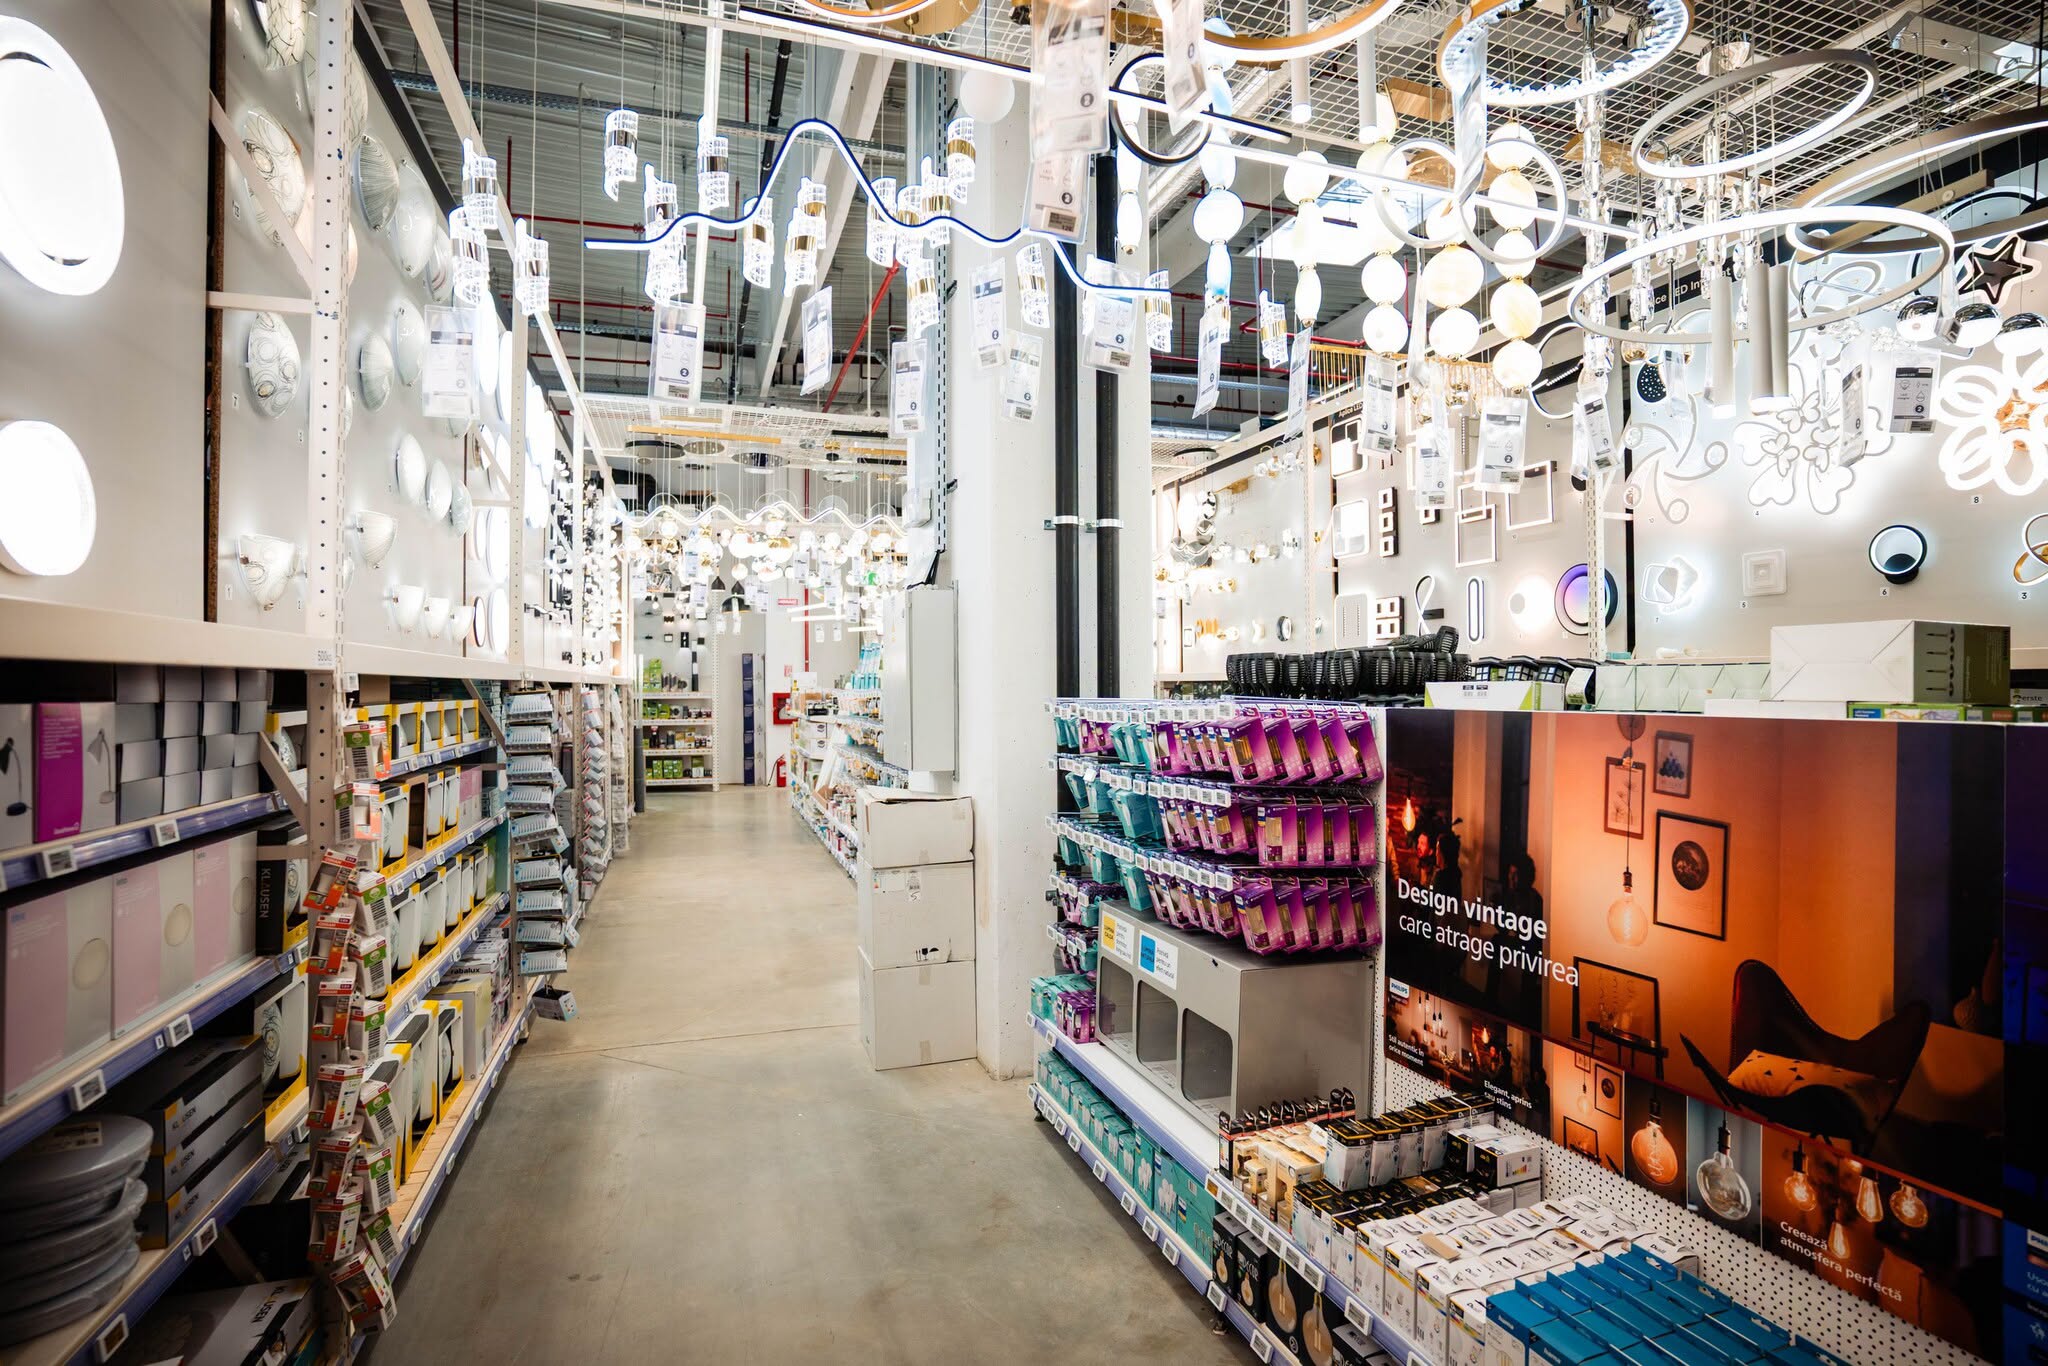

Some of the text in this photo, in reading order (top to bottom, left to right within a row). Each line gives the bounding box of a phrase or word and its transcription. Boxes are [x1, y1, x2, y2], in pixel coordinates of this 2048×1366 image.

[260, 867, 272, 918] KLAUSEN
[1398, 878, 1548, 941] Design vintage
[1399, 914, 1580, 986] care atrage privirea
[1484, 1080, 1510, 1099] Elegant,
[1780, 1221, 1828, 1251] Creează
[1780, 1236, 1902, 1301] atmosfera perfectă
